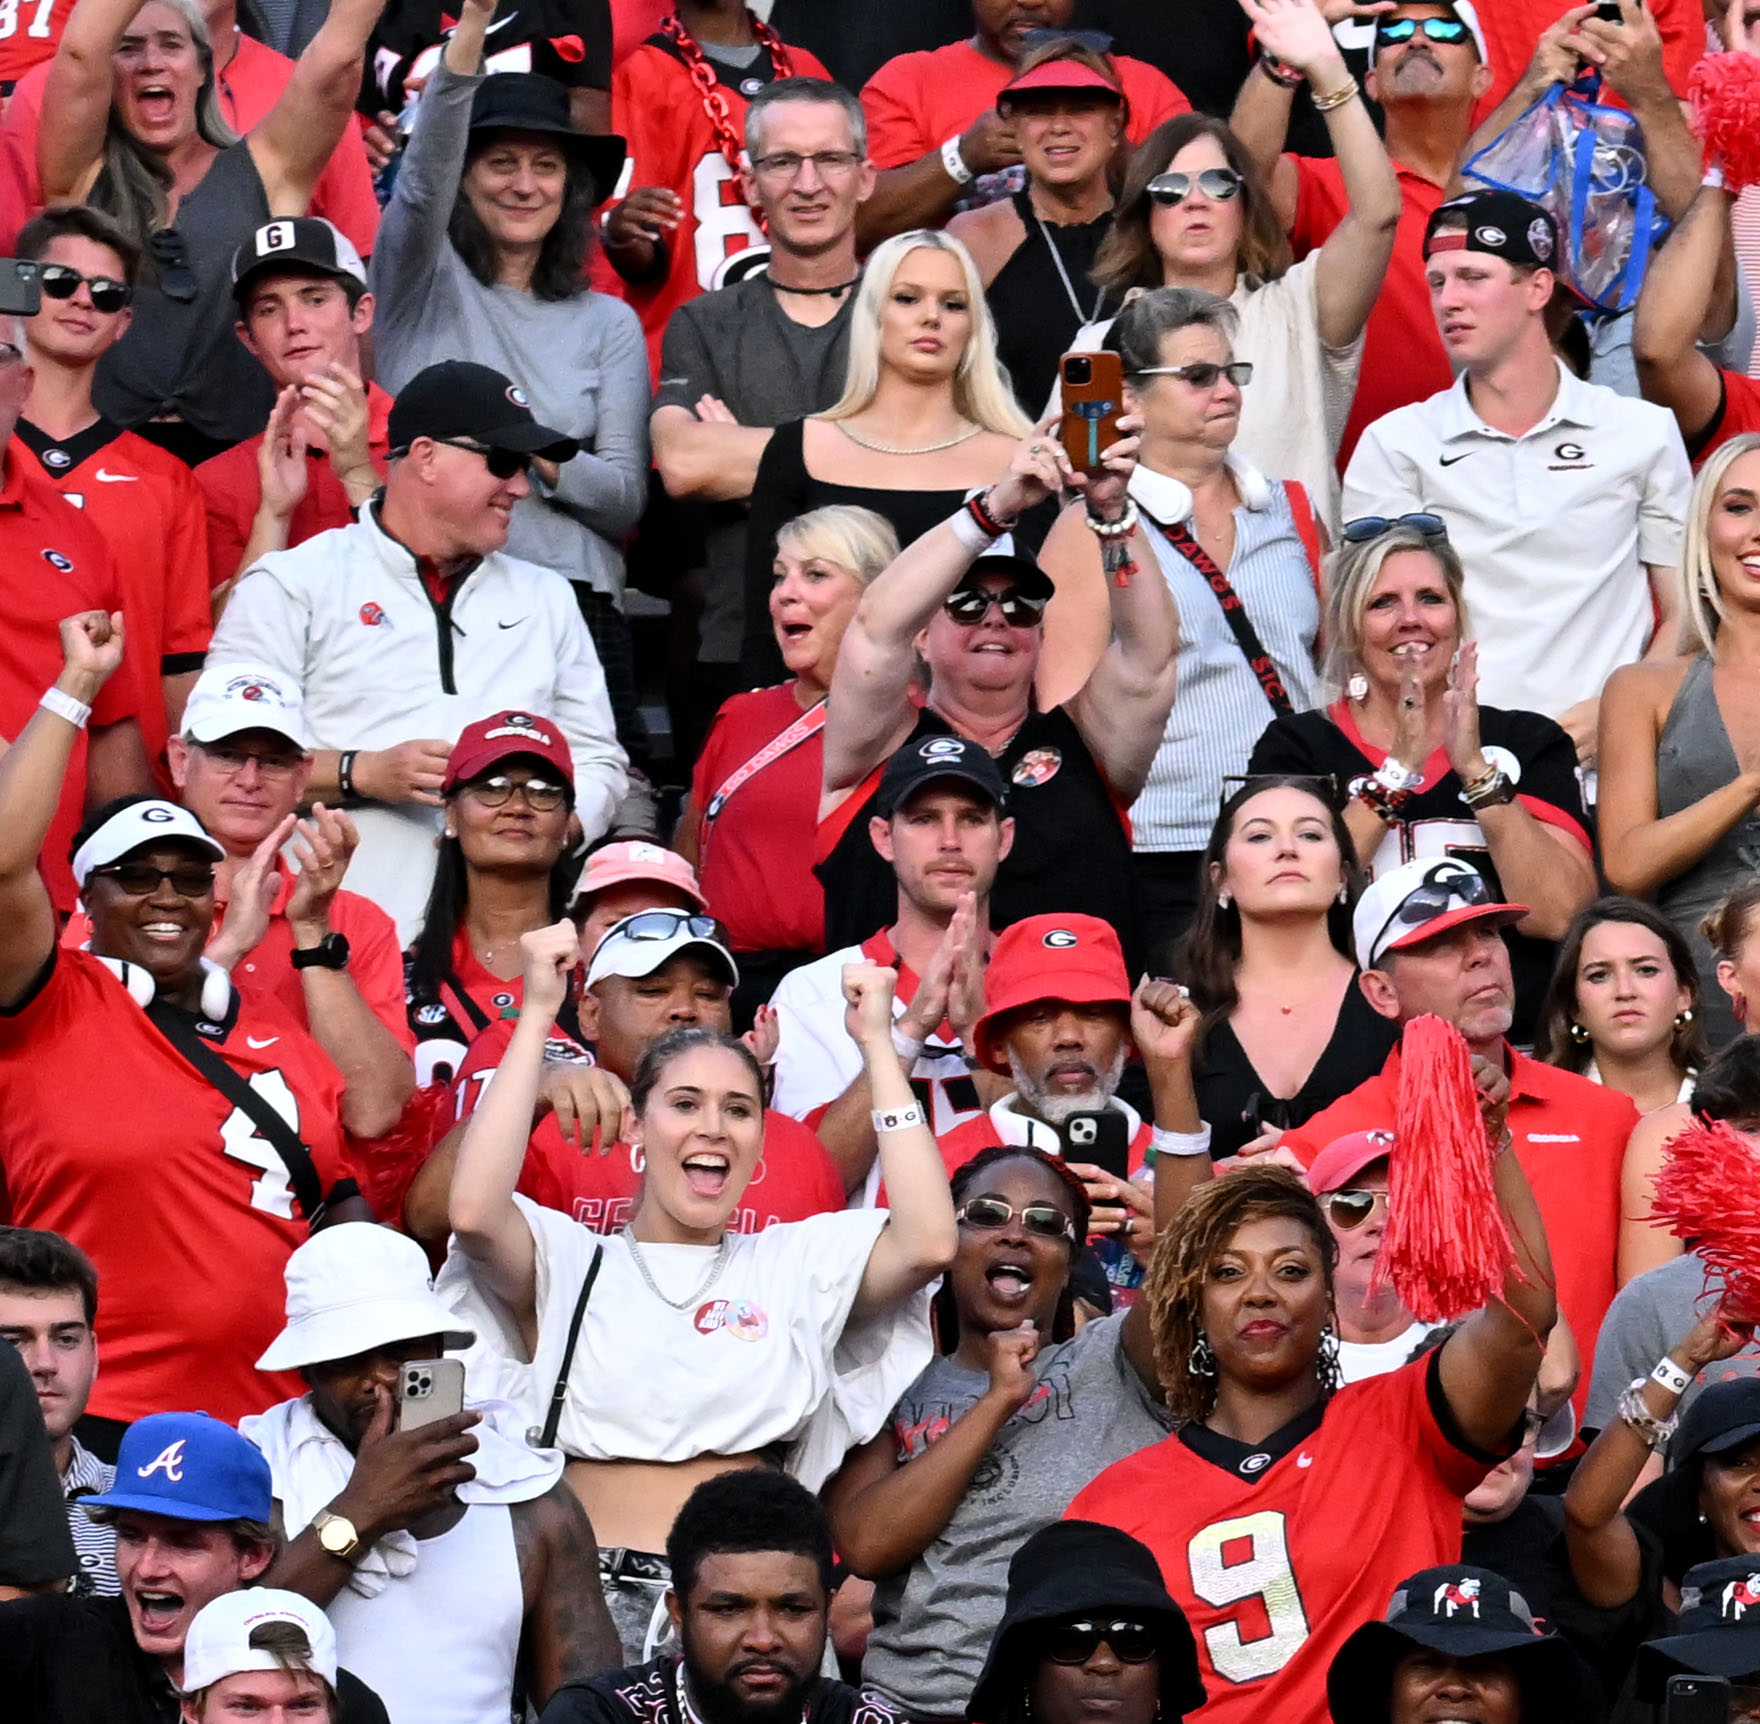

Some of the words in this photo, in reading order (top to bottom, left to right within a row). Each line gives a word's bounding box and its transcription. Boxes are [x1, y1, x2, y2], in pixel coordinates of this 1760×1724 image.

[267, 224, 283, 249] G
[1479, 227, 1503, 245] G
[1555, 443, 1585, 459] G
[923, 739, 966, 754] G
[142, 808, 175, 822] G
[1043, 930, 1077, 948] G
[138, 1440, 184, 1481] A
[1242, 1455, 1270, 1472] G
[1187, 1511, 1309, 1683] 9
